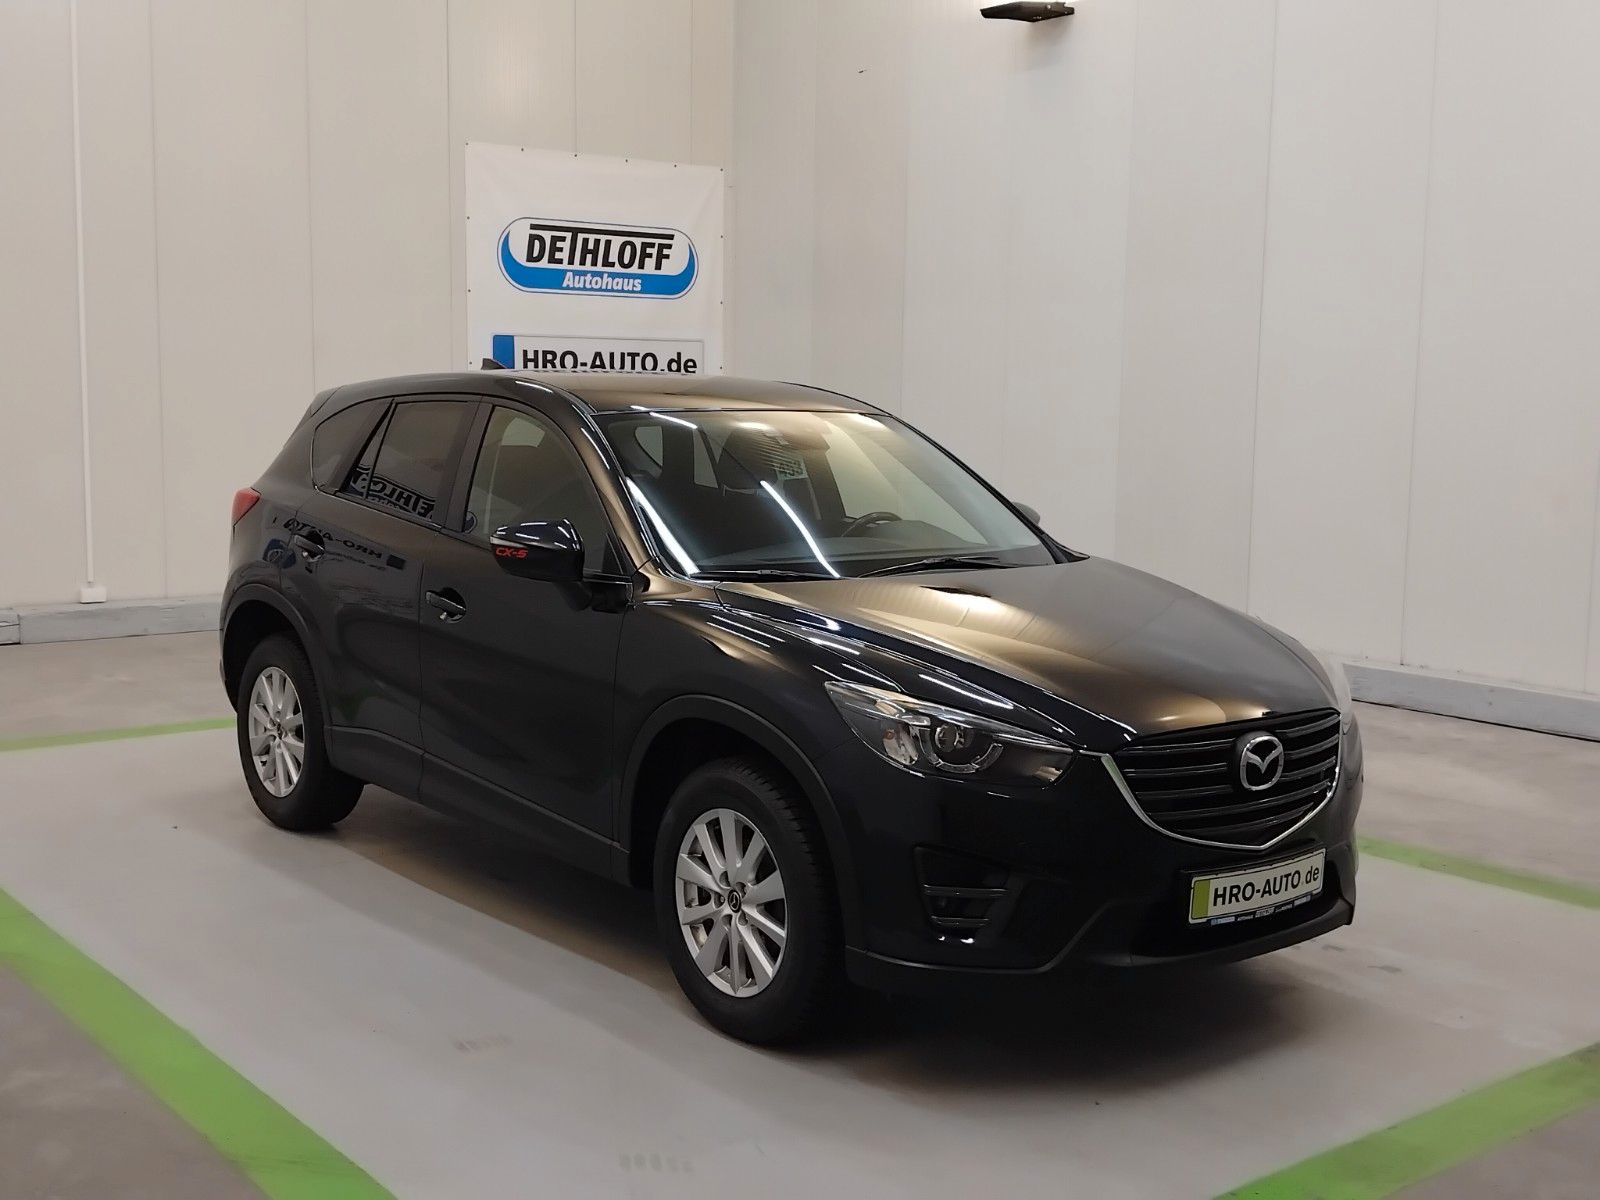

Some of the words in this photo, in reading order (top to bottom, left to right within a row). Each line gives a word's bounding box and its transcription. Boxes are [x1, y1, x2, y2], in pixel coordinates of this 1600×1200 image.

[525, 223, 675, 271] DETHLOFF
[562, 271, 642, 292] Autohaus
[521, 349, 698, 374] HRO-AUTO.de
[495, 546, 529, 559] CX-5
